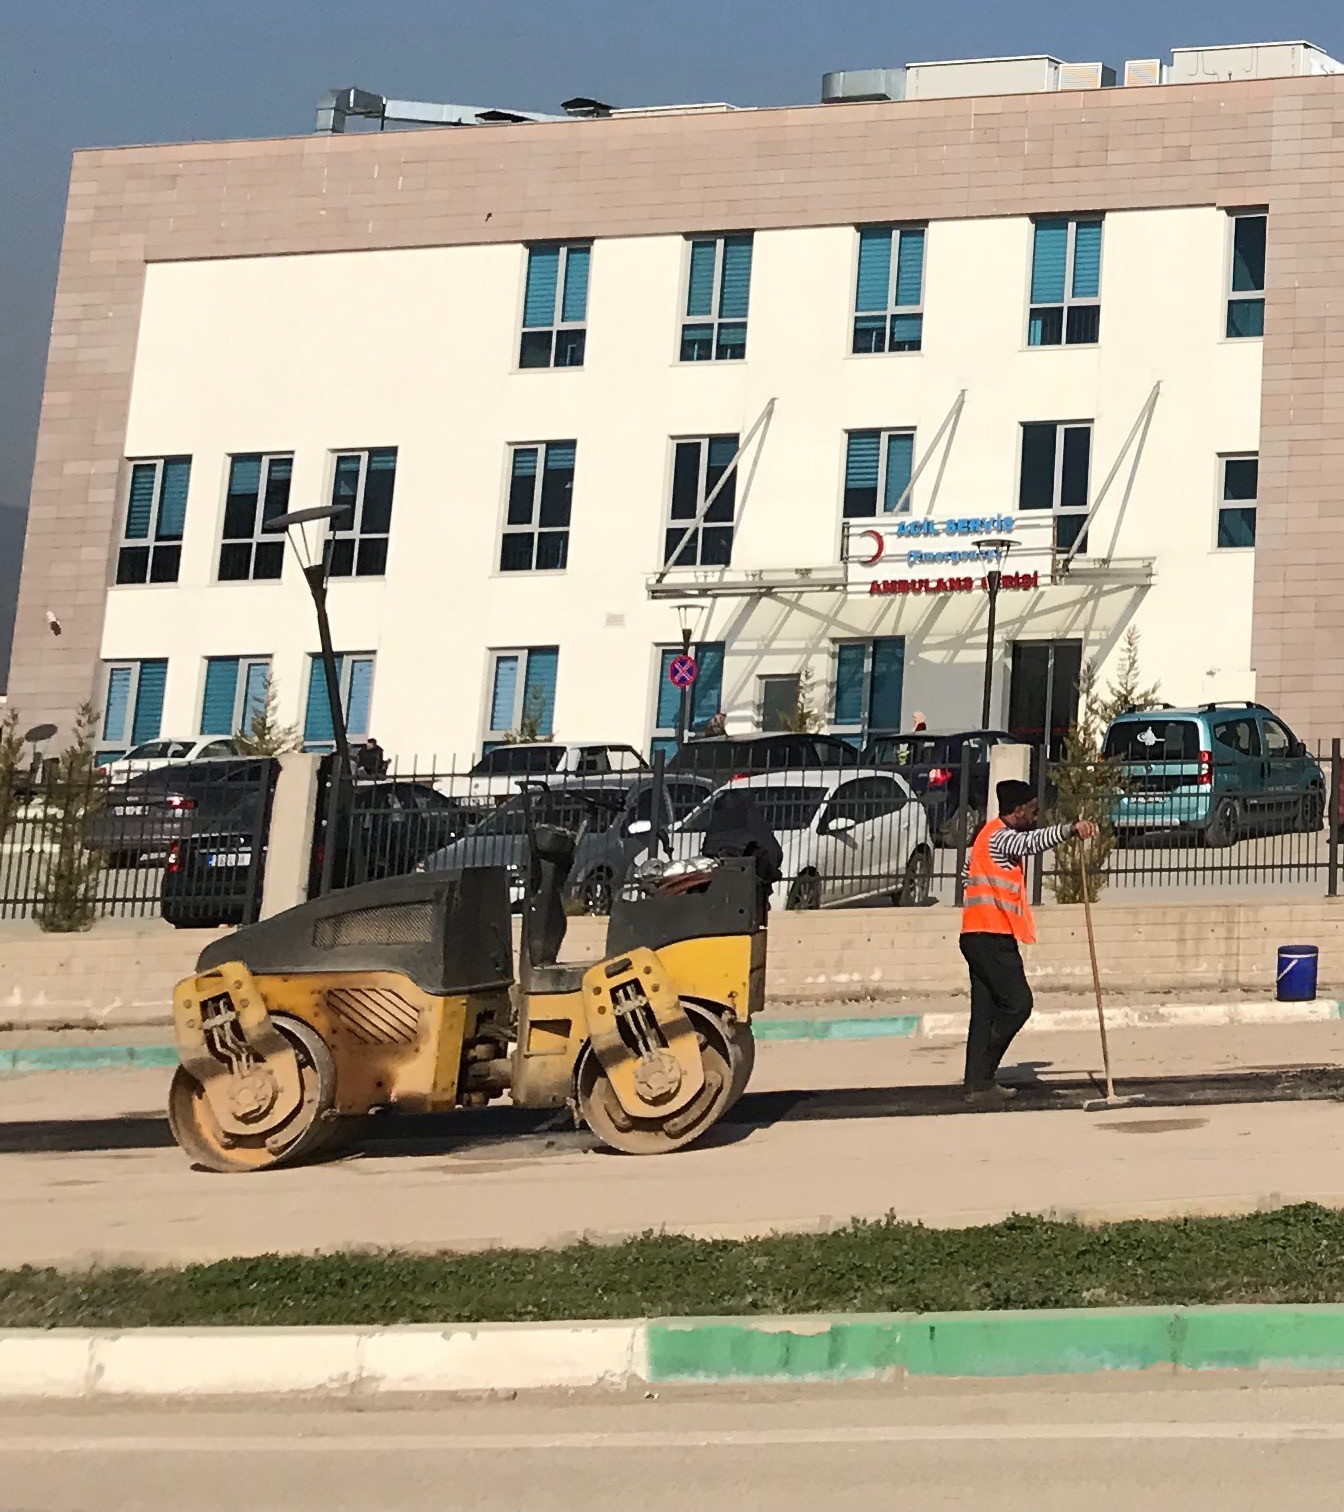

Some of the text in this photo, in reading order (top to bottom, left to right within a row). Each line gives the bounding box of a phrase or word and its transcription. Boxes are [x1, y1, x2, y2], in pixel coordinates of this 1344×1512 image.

[896, 513, 1014, 537] ACİL SERVİS
[869, 576, 974, 593] AMBULANS
